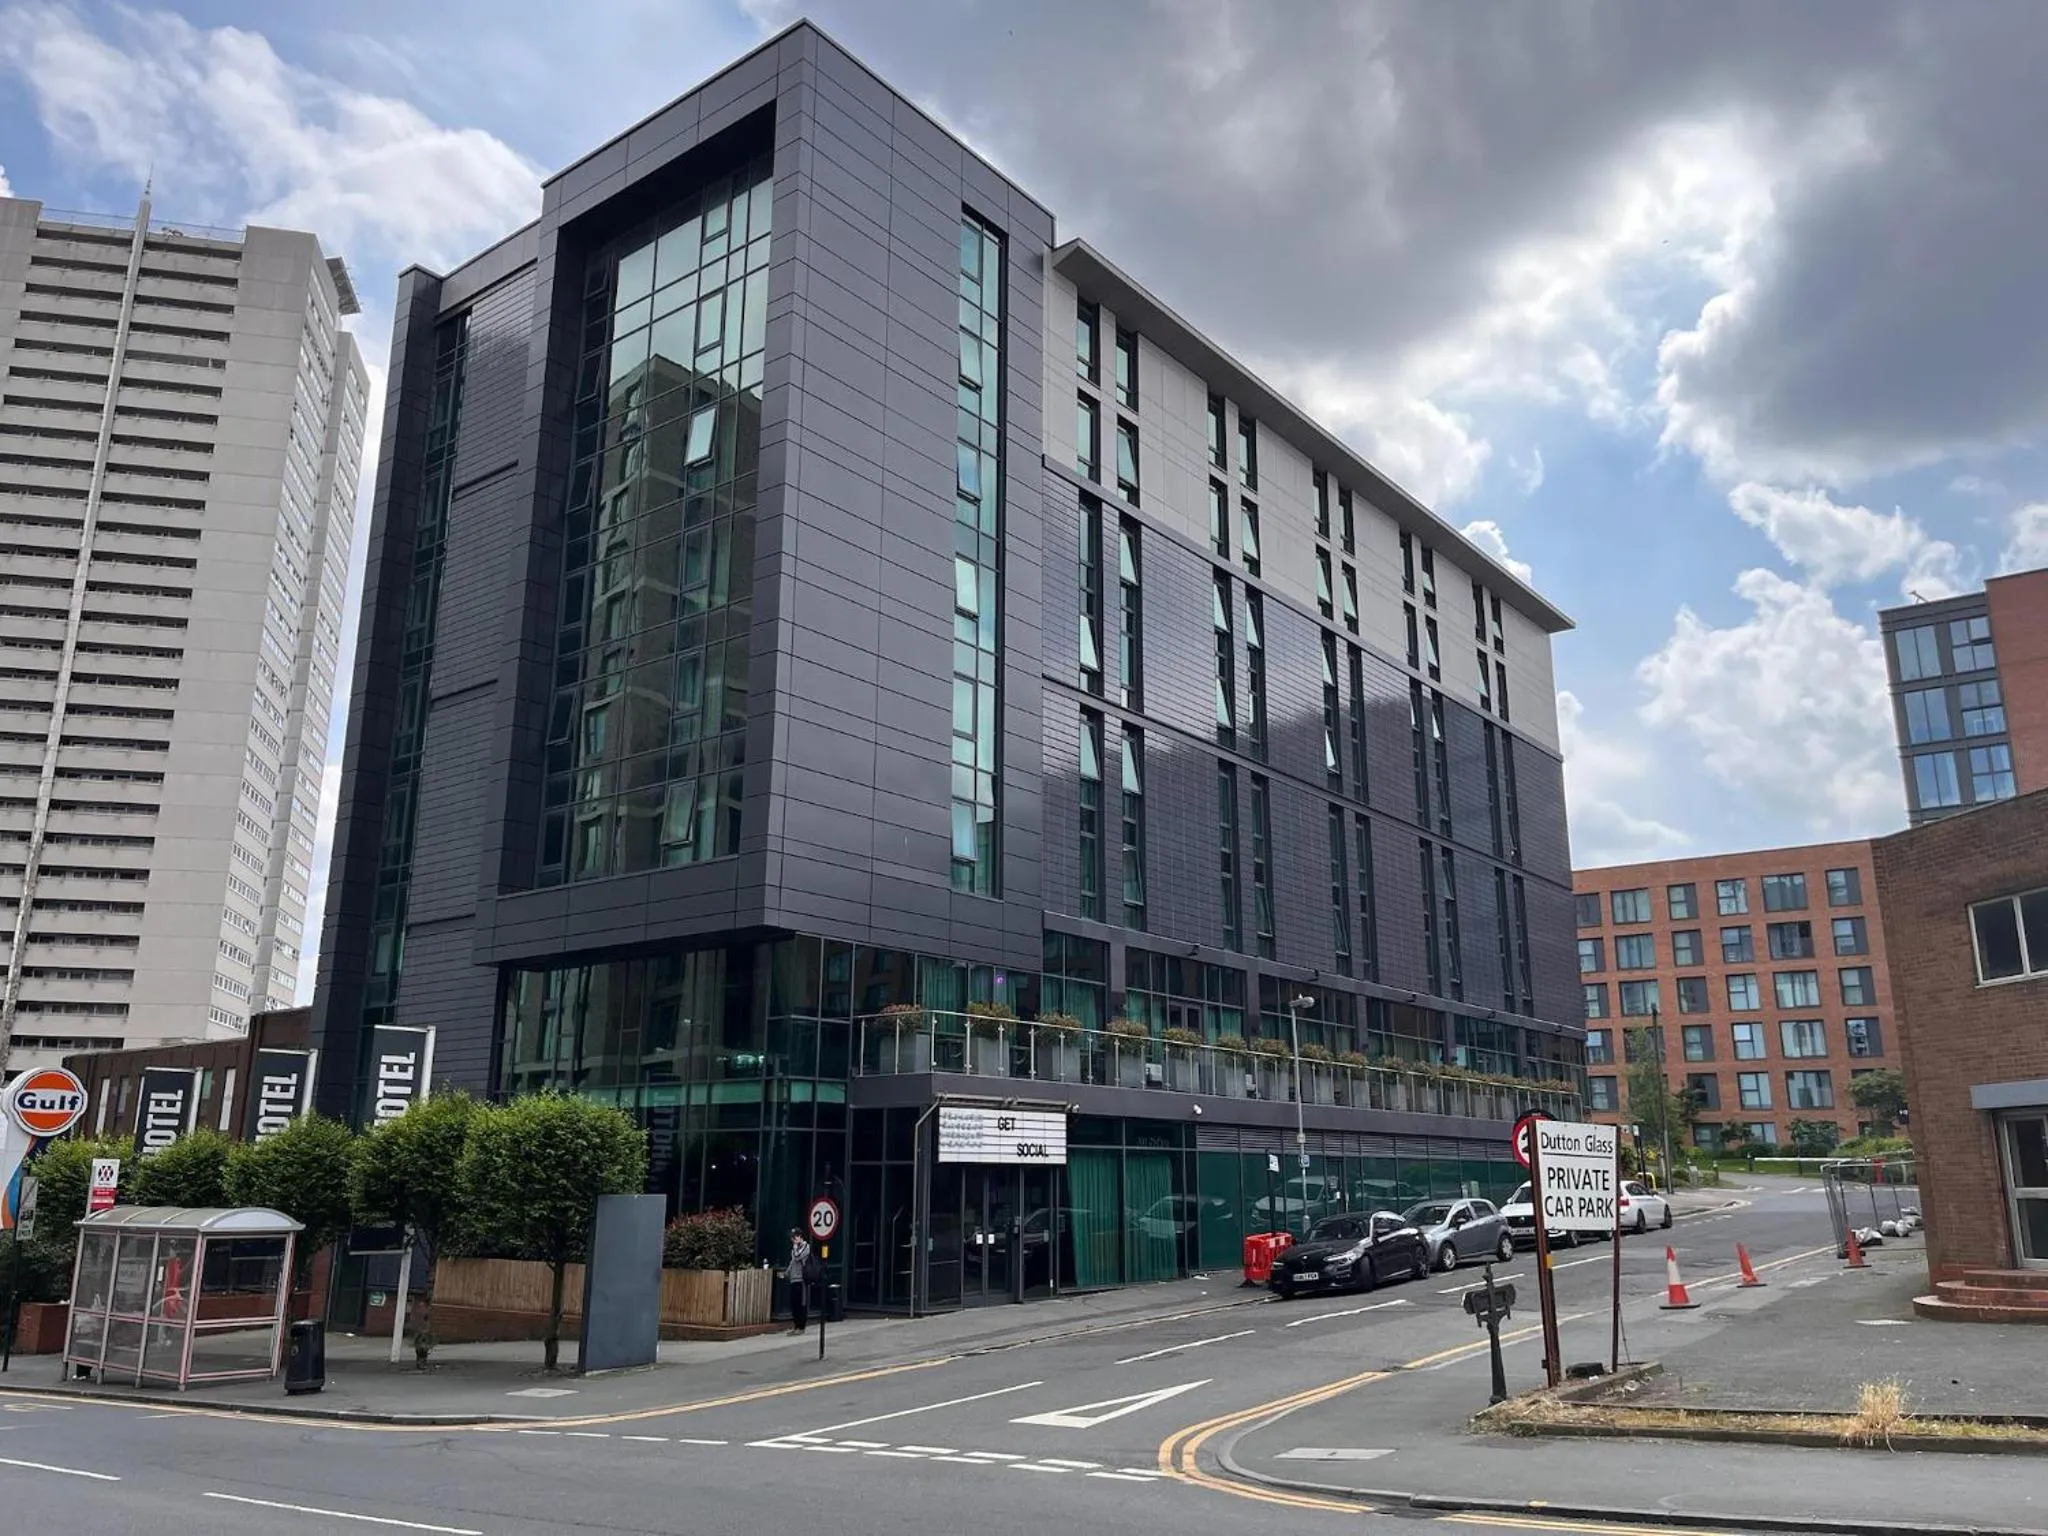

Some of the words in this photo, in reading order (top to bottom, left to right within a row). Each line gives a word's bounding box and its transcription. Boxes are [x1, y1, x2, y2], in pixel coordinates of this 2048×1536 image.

[18, 1092, 80, 1111] Gulf
[998, 1116, 1016, 1131] GET
[1016, 1143, 1049, 1157] SOCIAL
[1541, 1132, 1580, 1151] Dutton
[1585, 1135, 1614, 1153] Glass
[1547, 1167, 1610, 1191] PRIVATE
[1544, 1196, 1575, 1217] CAR
[1579, 1197, 1614, 1218] PARK
[813, 1211, 834, 1227] 20
